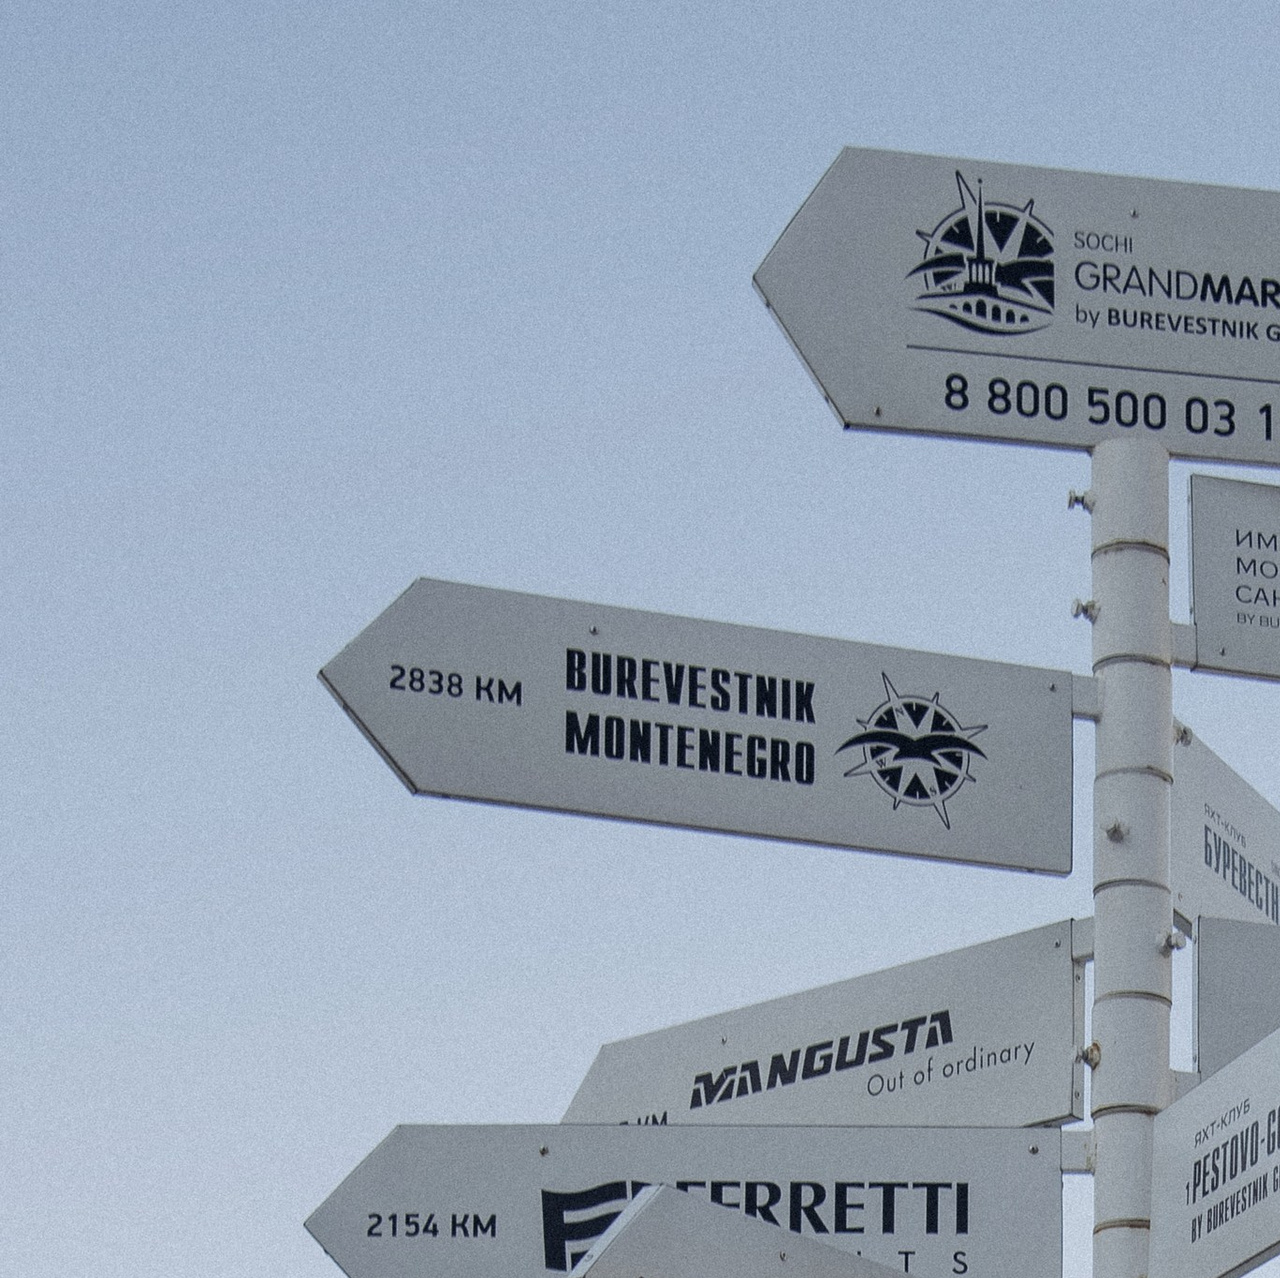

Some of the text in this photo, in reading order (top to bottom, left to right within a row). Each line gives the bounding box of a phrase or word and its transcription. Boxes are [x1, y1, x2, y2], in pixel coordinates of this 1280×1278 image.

[1073, 230, 1133, 254] SOCHI
[1075, 303, 1101, 329] by
[1107, 307, 1259, 340] BUREVESTNIK
[944, 373, 969, 411] 8
[987, 377, 1068, 421] 800
[1087, 386, 1167, 431] 500
[1185, 396, 1236, 437] 03
[1236, 611, 1256, 625] BY
[389, 664, 464, 698] 2838
[565, 648, 816, 724] BUREVESTNIK
[565, 710, 815, 786] MONTENEGRO
[1204, 803, 1247, 848] ЯХТ-КЛУБ
[689, 1009, 954, 1110] MANGUSTA
[866, 1041, 1035, 1097] Out of ordinary
[1194, 1098, 1250, 1149] ЯХТ-КЛУБ
[366, 1213, 439, 1238] 2154
[676, 1180, 970, 1235] ERRETTI
[1191, 1213, 1203, 1244] BY
[1207, 1172, 1268, 1234] BUREVESTNIK
